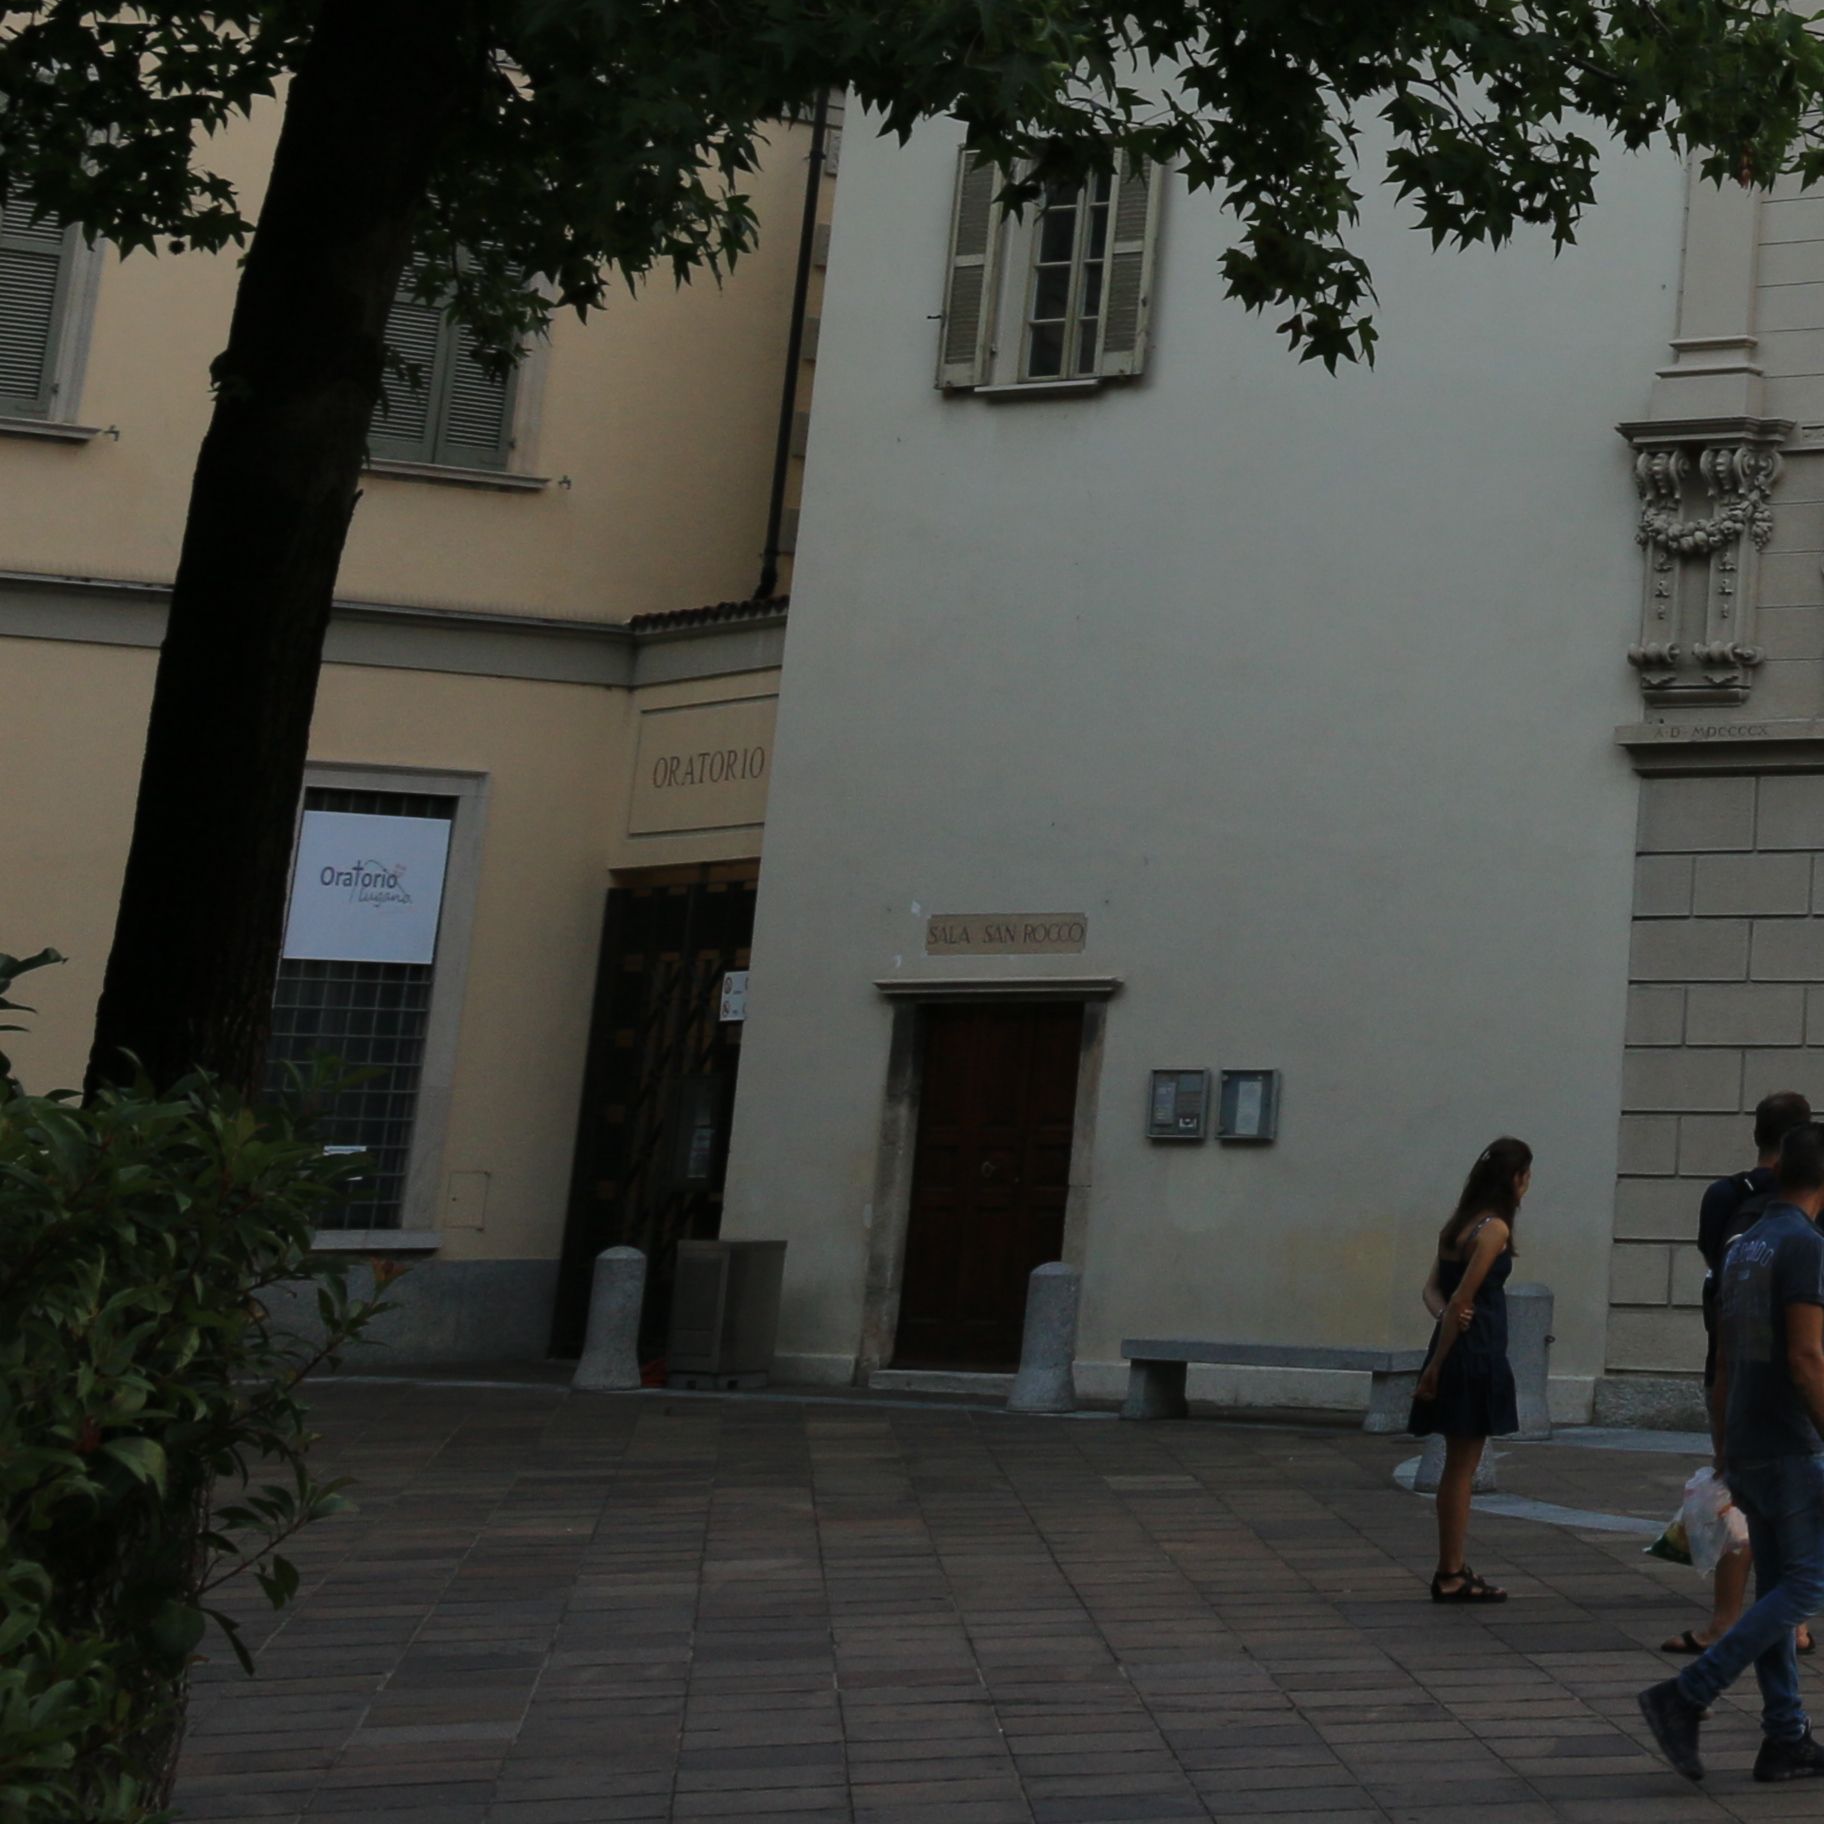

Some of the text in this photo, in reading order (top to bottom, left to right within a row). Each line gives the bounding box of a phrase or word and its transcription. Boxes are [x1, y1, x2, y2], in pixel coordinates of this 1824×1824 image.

[652, 746, 766, 789] ORATORIO
[320, 859, 398, 889] Oratorio
[927, 921, 1085, 945] SALA SAN ROCCO
